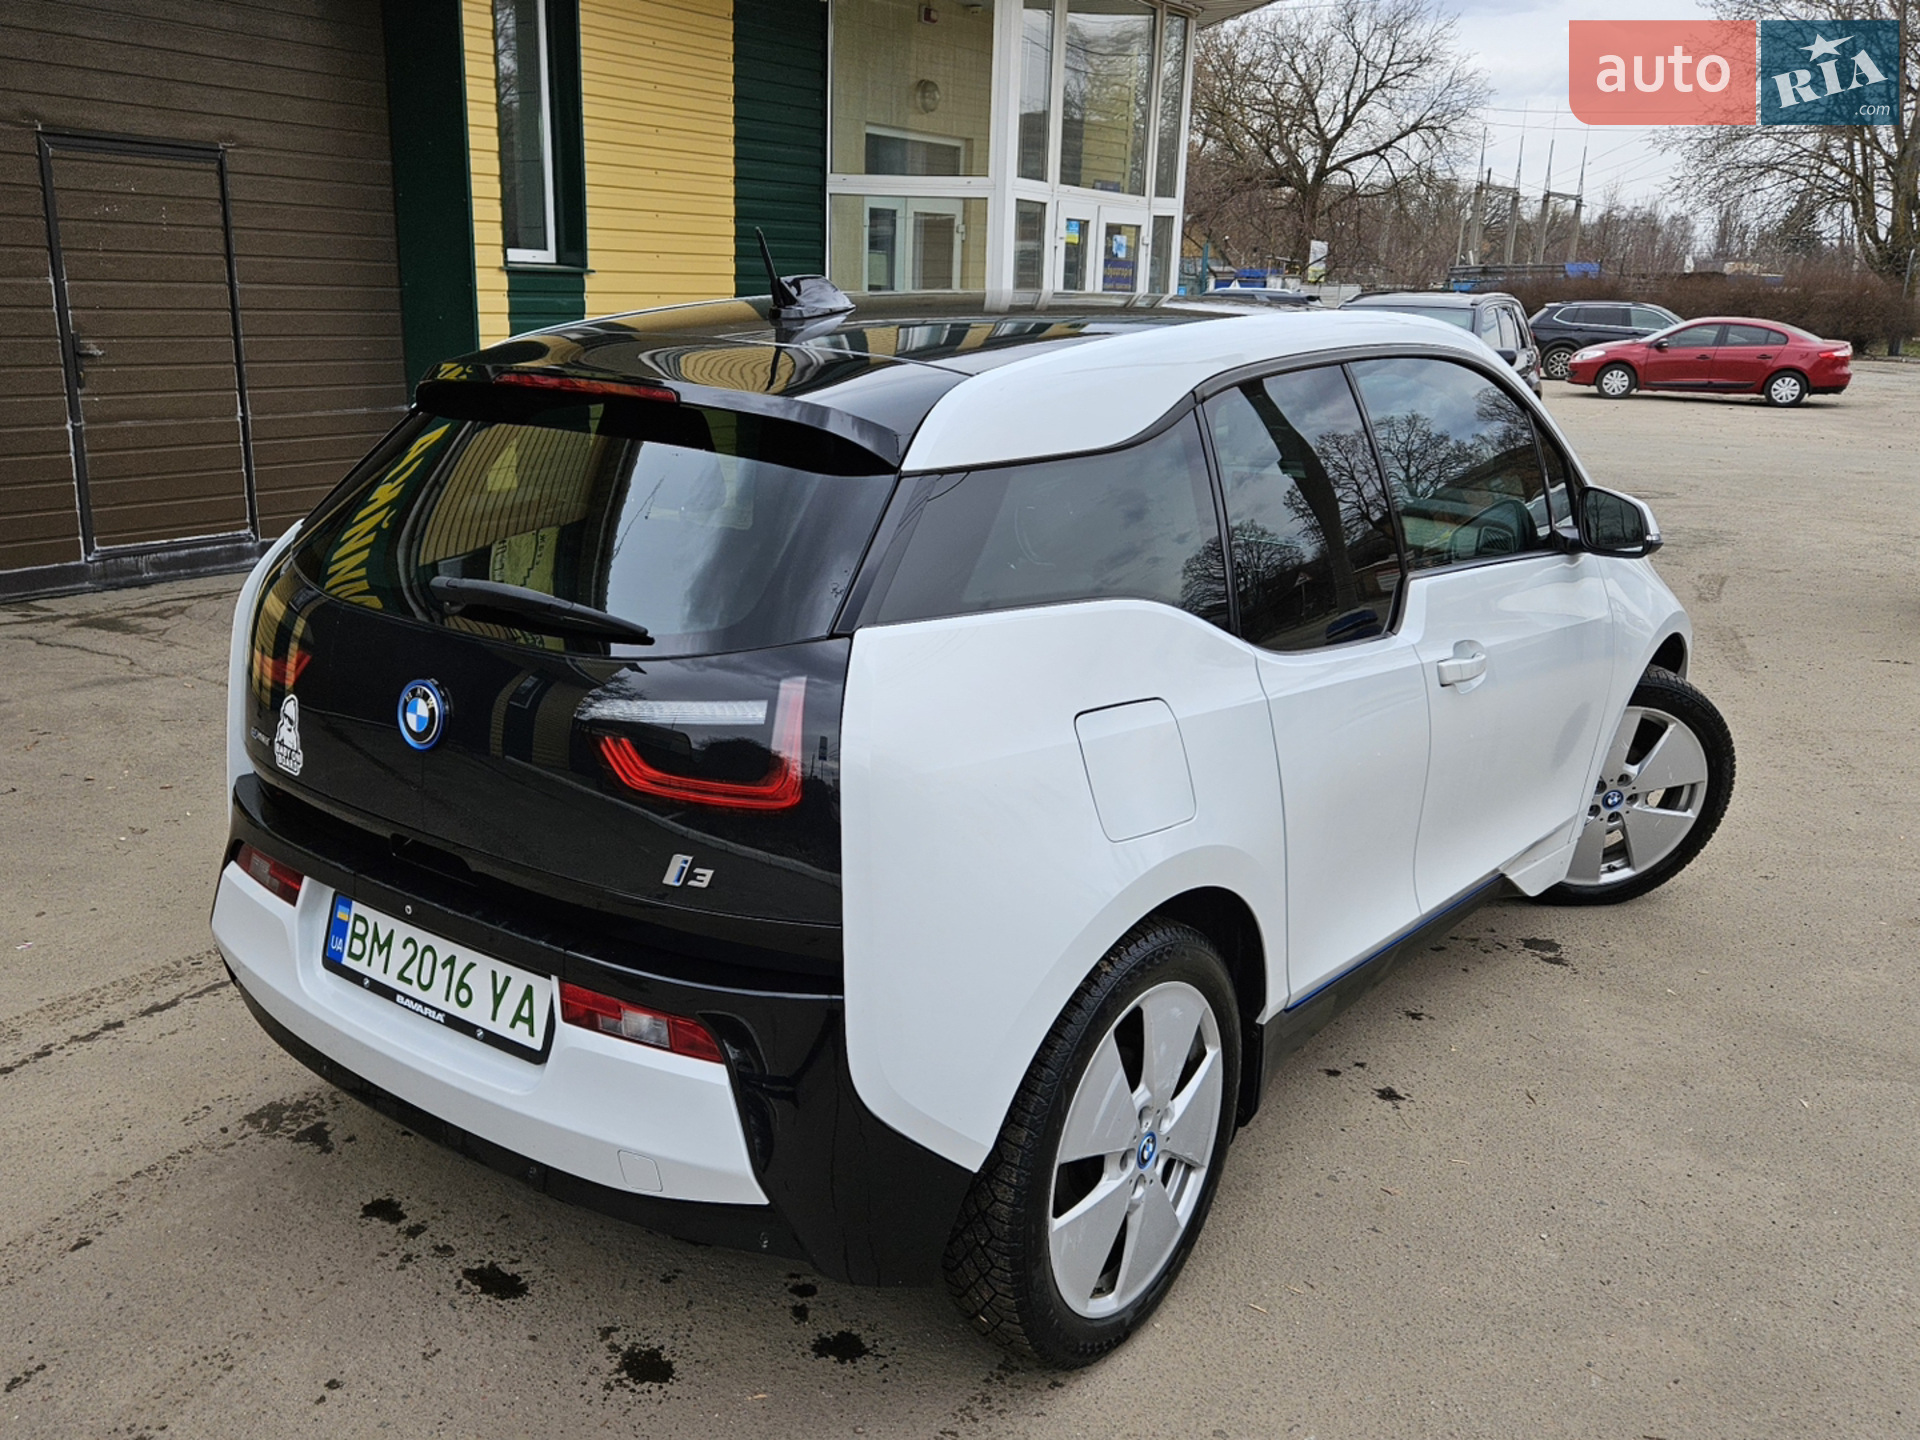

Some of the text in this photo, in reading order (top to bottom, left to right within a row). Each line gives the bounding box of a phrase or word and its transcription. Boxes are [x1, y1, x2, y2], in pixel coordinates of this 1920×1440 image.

[330, 935, 344, 953] UA
[346, 912, 536, 1039] BM 2016 YA
[396, 994, 445, 1023] BAVARIA
